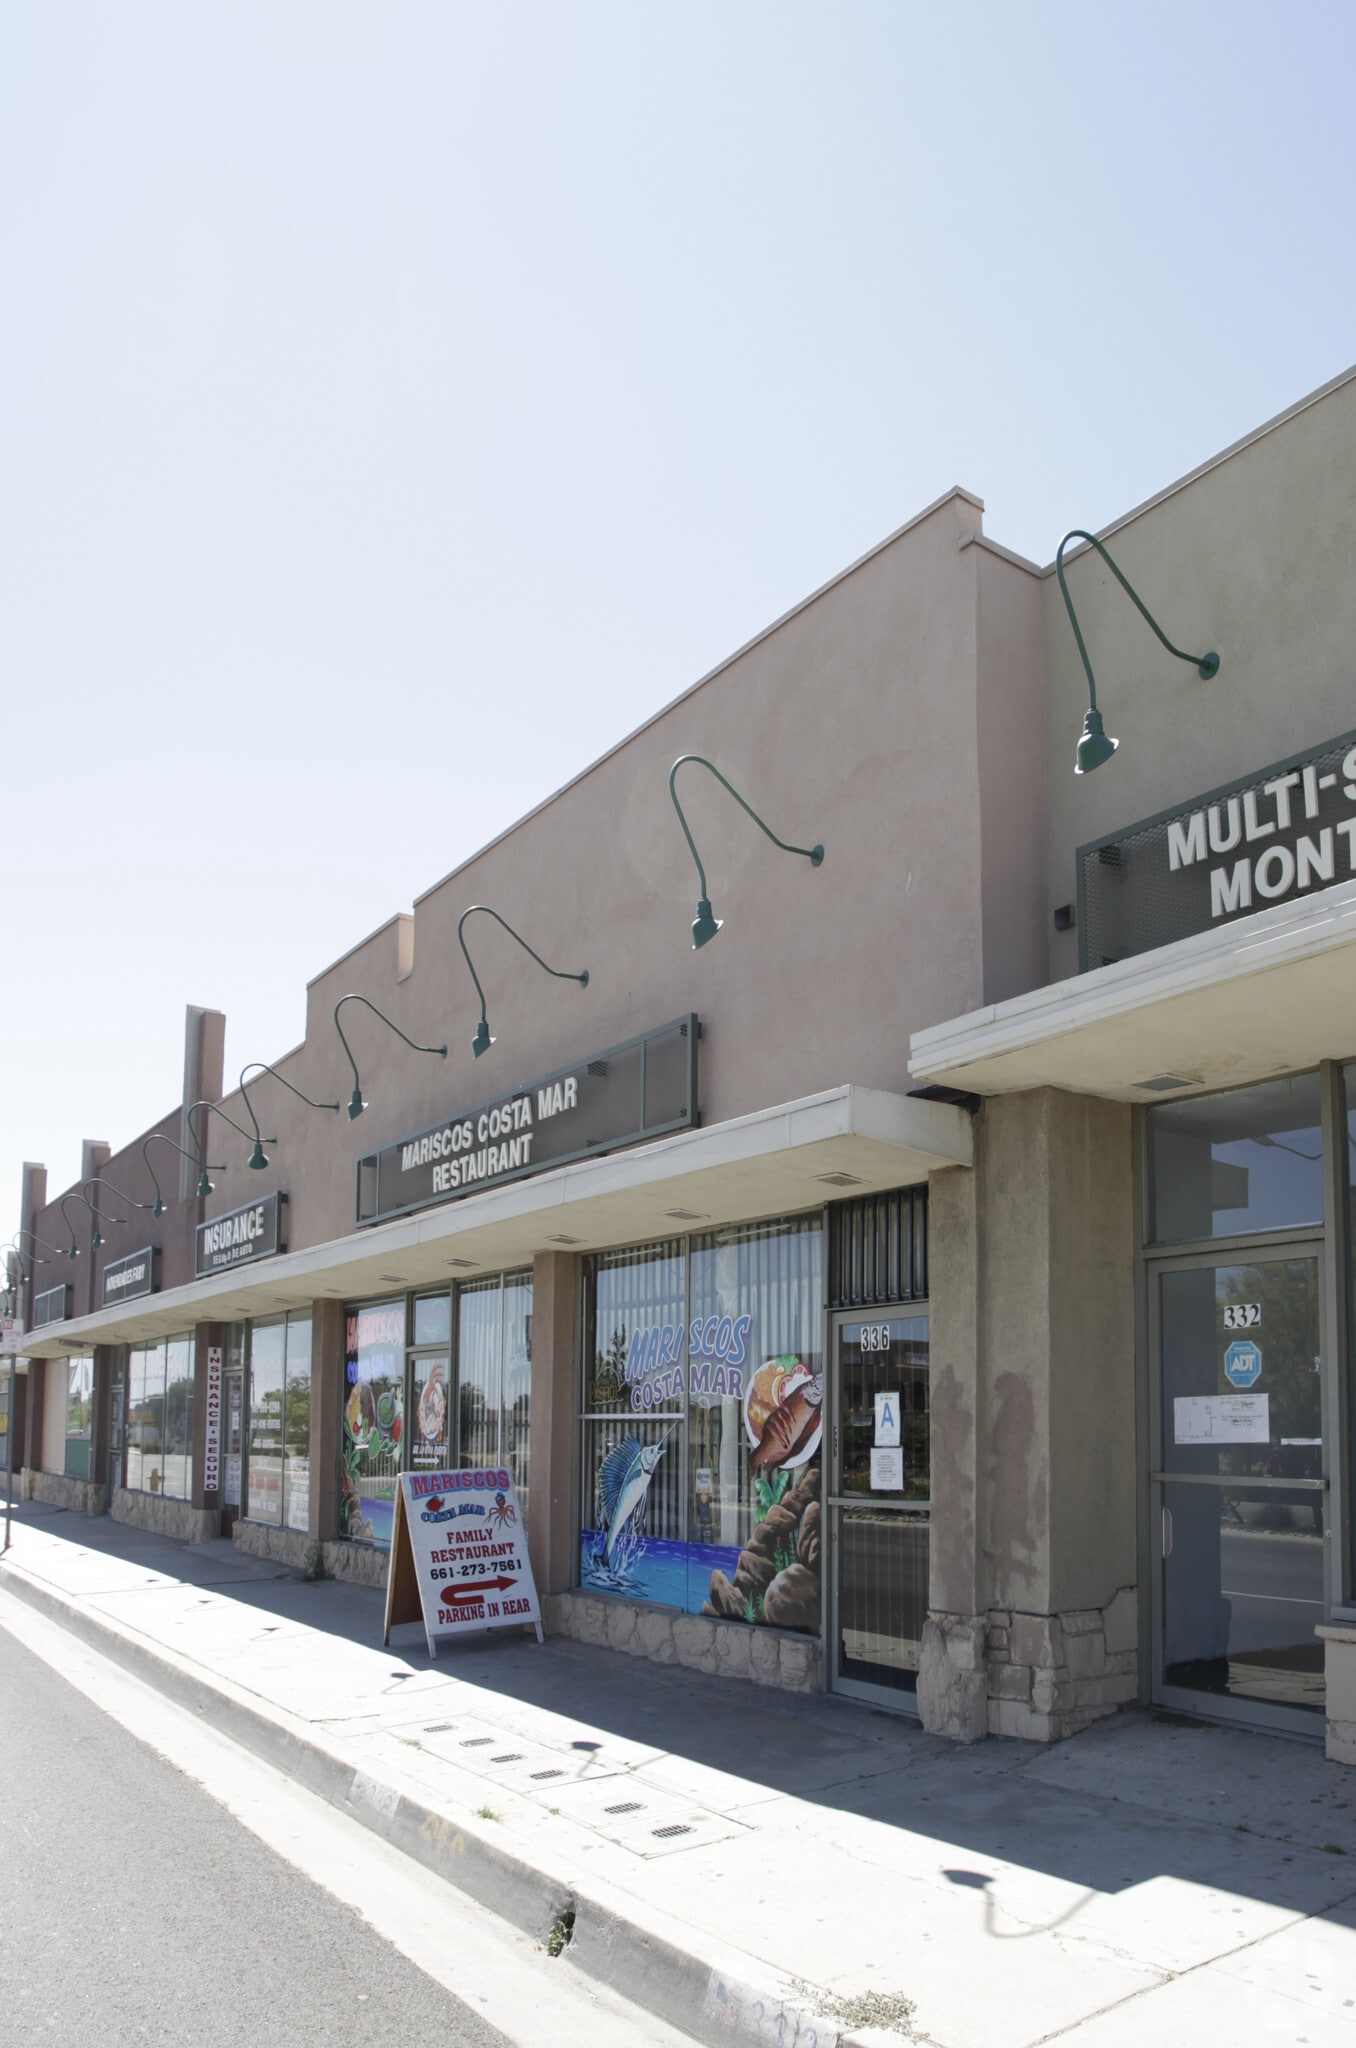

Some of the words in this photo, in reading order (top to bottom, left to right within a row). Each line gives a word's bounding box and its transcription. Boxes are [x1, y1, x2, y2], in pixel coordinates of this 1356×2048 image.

[401, 1121, 474, 1171] MARISCOS
[477, 1096, 533, 1143] COSTA
[538, 1077, 578, 1120] MAR
[432, 1133, 533, 1193] RESTAURANT
[204, 1206, 264, 1255] INSURANCE
[1225, 1304, 1259, 1328] 332
[625, 1314, 751, 1383] MARISCOS
[862, 1326, 889, 1350] 336
[1231, 1354, 1255, 1371] ADT
[208, 1348, 220, 1427] INSURANCE
[631, 1368, 686, 1413] COSTA
[689, 1363, 743, 1400] MAR
[881, 1402, 894, 1427] A
[205, 1438, 218, 1490] SEGURO
[409, 1469, 511, 1500] MARISCOS
[421, 1507, 456, 1523] COSTA
[458, 1503, 485, 1517] MAR
[447, 1528, 493, 1544] FAMILY
[431, 1542, 514, 1563] RESTAURANT
[430, 1559, 522, 1580] 661-273-7561
[437, 1604, 485, 1624] PARKING
[488, 1602, 500, 1617] IN
[503, 1598, 531, 1616] REAR
